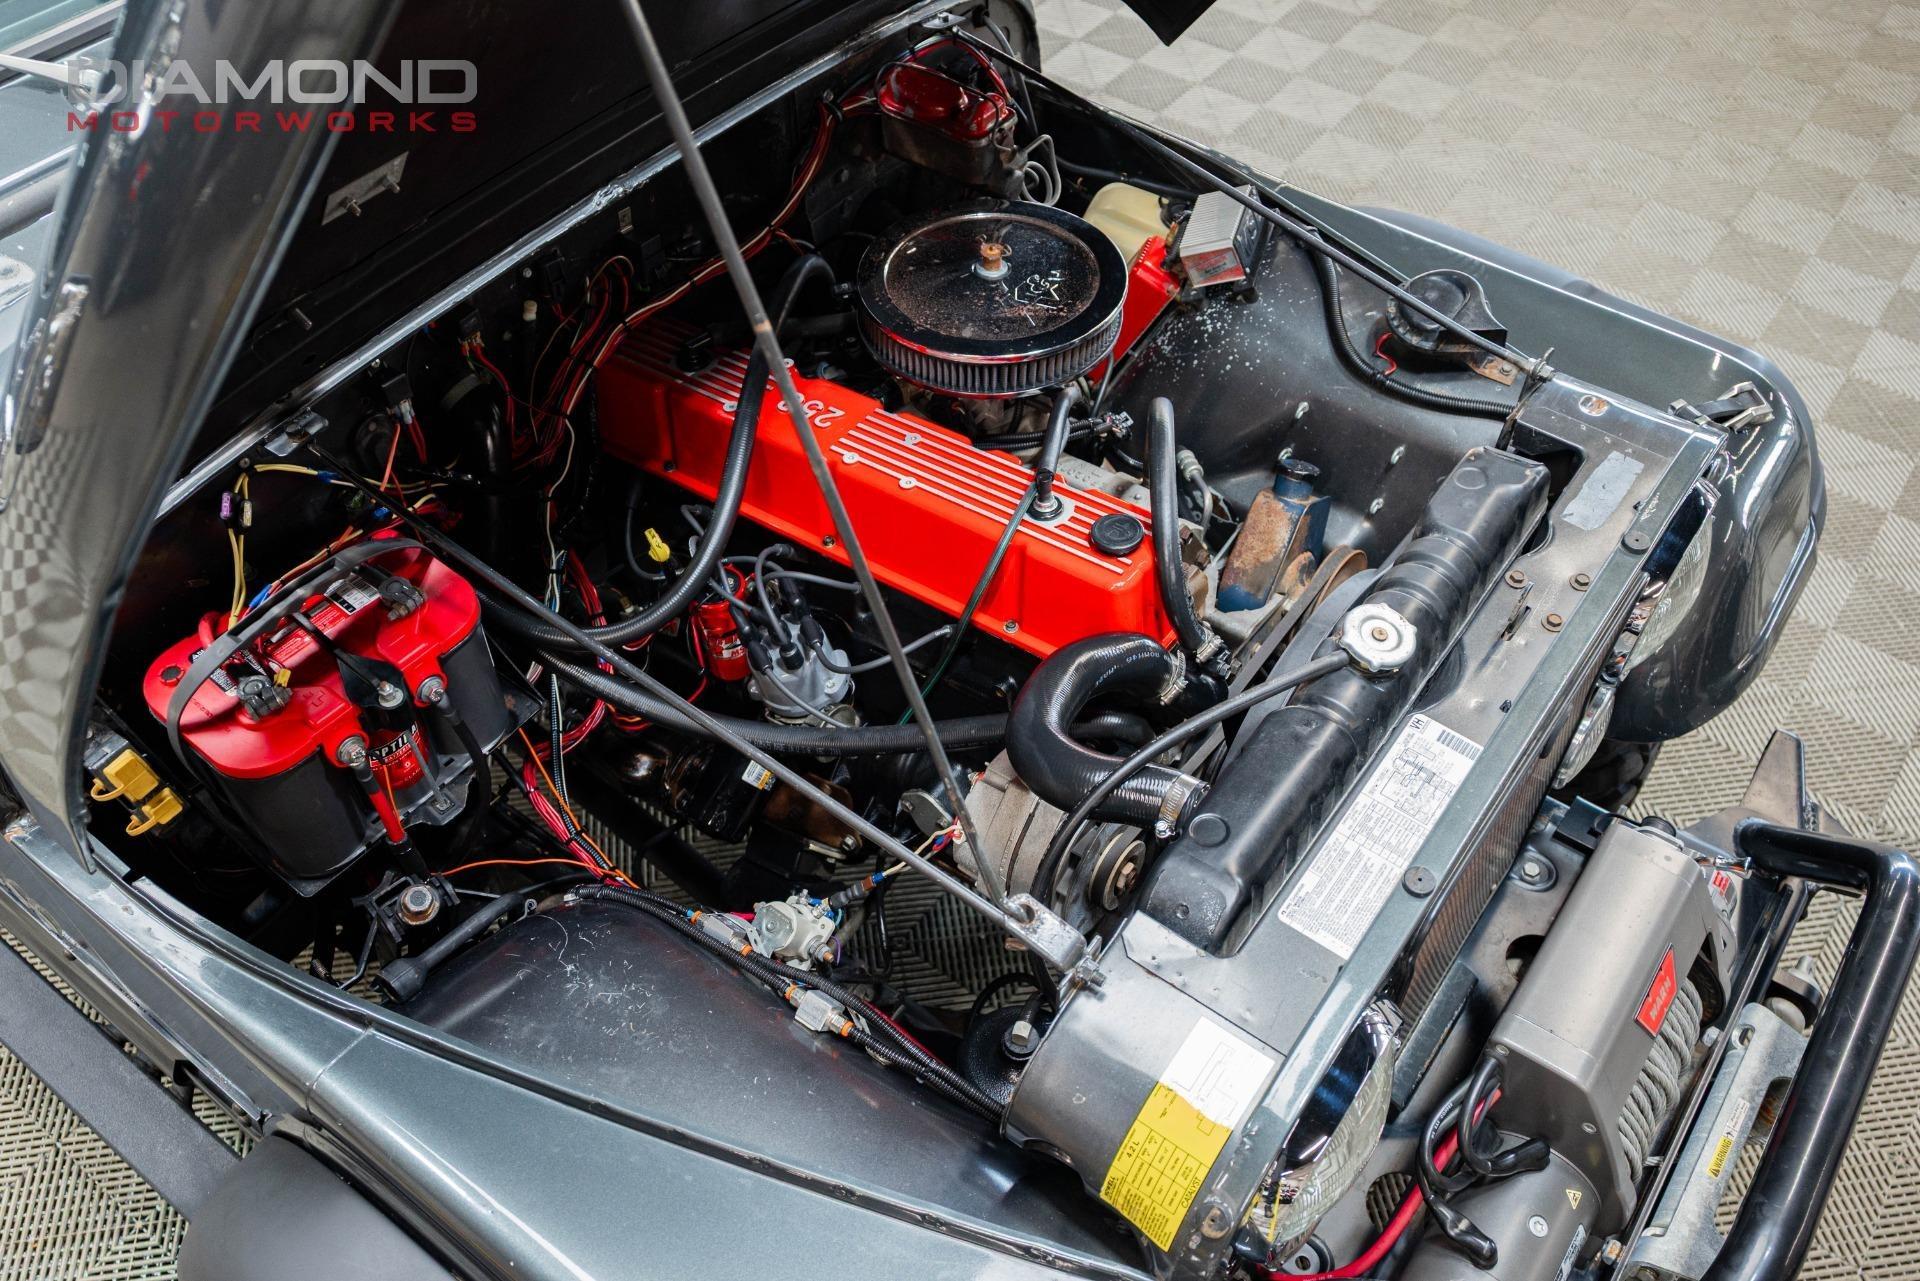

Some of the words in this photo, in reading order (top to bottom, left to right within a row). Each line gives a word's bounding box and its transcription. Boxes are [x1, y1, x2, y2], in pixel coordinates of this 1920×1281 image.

[1649, 975, 1672, 1021] WARN
[1713, 1138, 1732, 1169] WARNING
[1181, 1176, 1201, 1209] CATALYST
